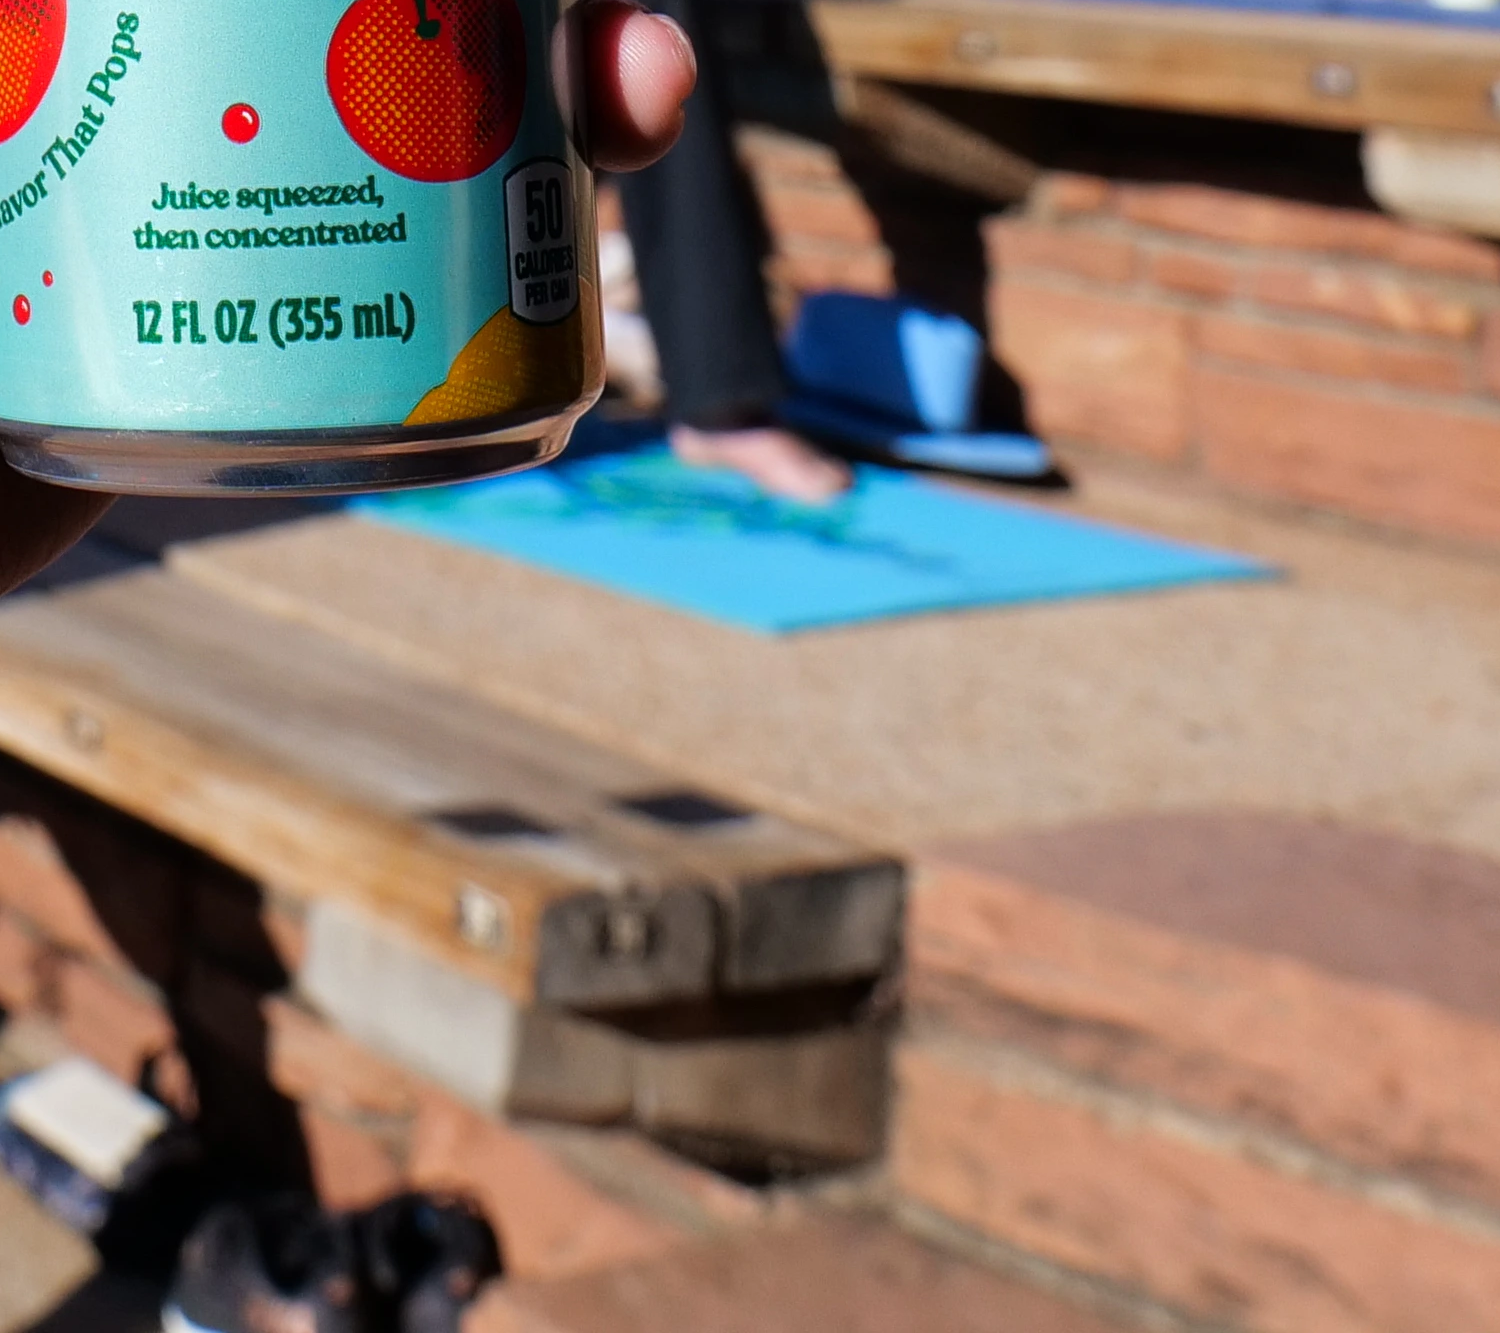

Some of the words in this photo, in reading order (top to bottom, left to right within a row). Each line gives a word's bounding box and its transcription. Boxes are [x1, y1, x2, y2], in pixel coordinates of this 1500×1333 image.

[41, 103, 106, 181] That
[86, 10, 142, 107] Pops
[151, 181, 230, 210] Juice
[236, 174, 384, 215] squeezed,
[525, 177, 563, 243] 50
[133, 221, 200, 250] then
[204, 212, 407, 249] concentrated
[515, 245, 573, 280] CALORIES
[525, 281, 549, 307] PER
[550, 277, 570, 302] CAN
[132, 299, 163, 344] 12
[172, 299, 207, 344] FL
[214, 299, 258, 344] OZ
[269, 295, 343, 350] (355
[353, 290, 416, 344] mL)
